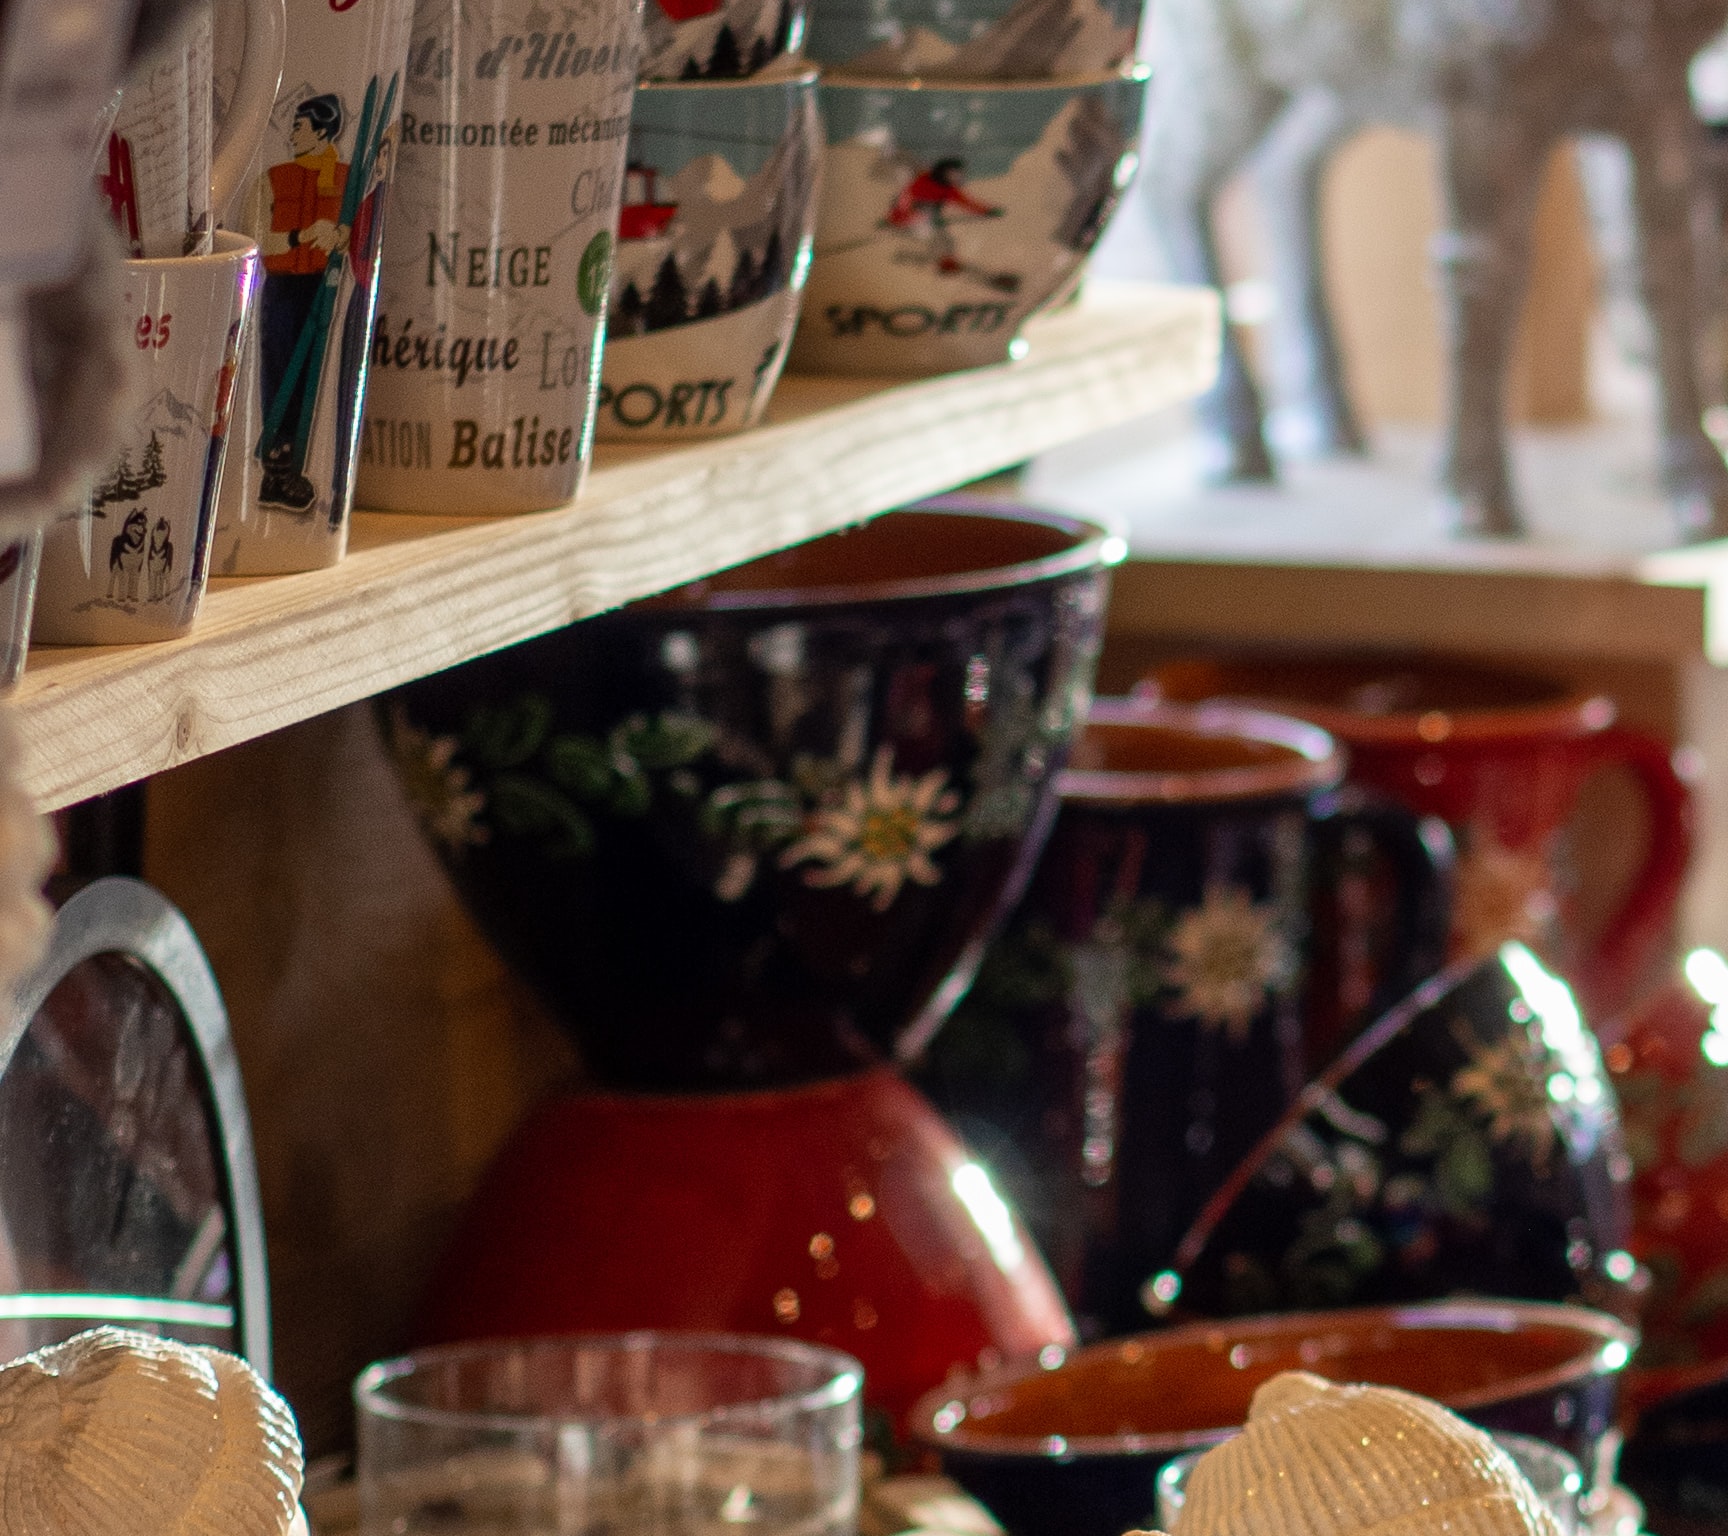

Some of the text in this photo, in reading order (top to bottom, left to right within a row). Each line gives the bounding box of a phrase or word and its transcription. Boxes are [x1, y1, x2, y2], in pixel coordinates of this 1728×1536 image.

[401, 114, 539, 148] Remontée
[426, 231, 551, 289] NEIGE
[372, 315, 519, 388] hérique
[599, 377, 736, 429] PORTS
[361, 415, 582, 470] ATION Balise
